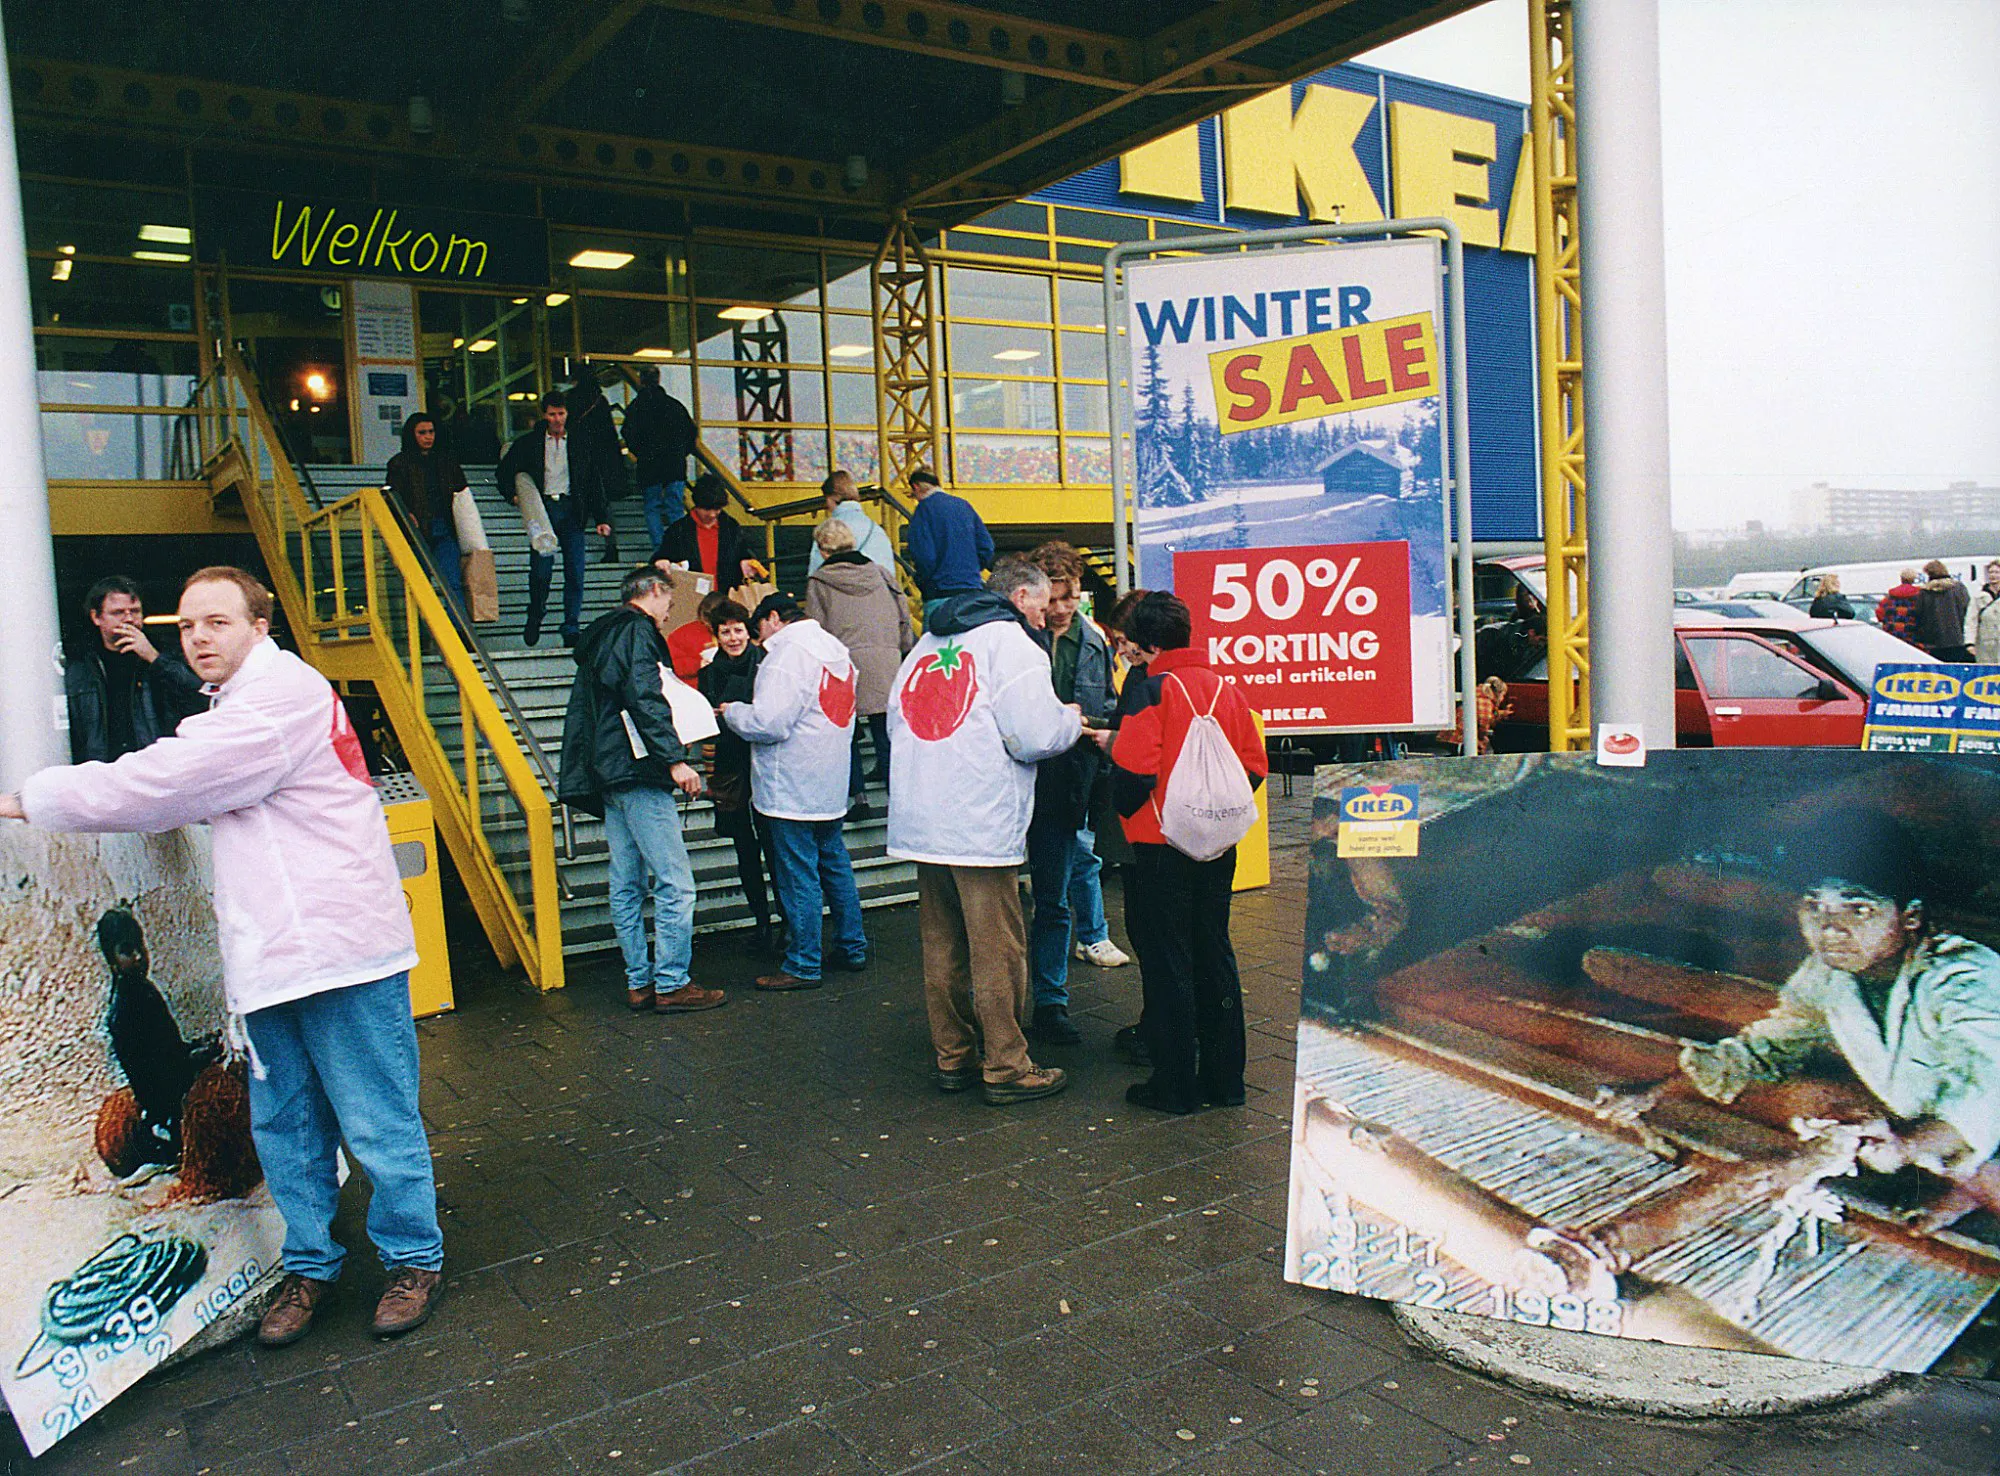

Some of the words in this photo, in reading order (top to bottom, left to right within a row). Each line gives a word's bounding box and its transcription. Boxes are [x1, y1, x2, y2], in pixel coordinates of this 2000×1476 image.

[272, 201, 488, 276] Welkom
[1135, 285, 1371, 346] WINTER
[1224, 322, 1431, 422] SALE
[1209, 557, 1378, 622] 50%
[1208, 630, 1380, 665] KORTING
[1242, 668, 1283, 684] veel
[1289, 665, 1377, 682] artikelen
[1884, 679, 1953, 694] IKEA
[1262, 707, 1327, 721] IKEA
[1875, 703, 1957, 718] FAMILY
[1353, 799, 1405, 813] IKEA
[1488, 1284, 1624, 1337] 1998
[51, 1294, 160, 1390] 9:39
